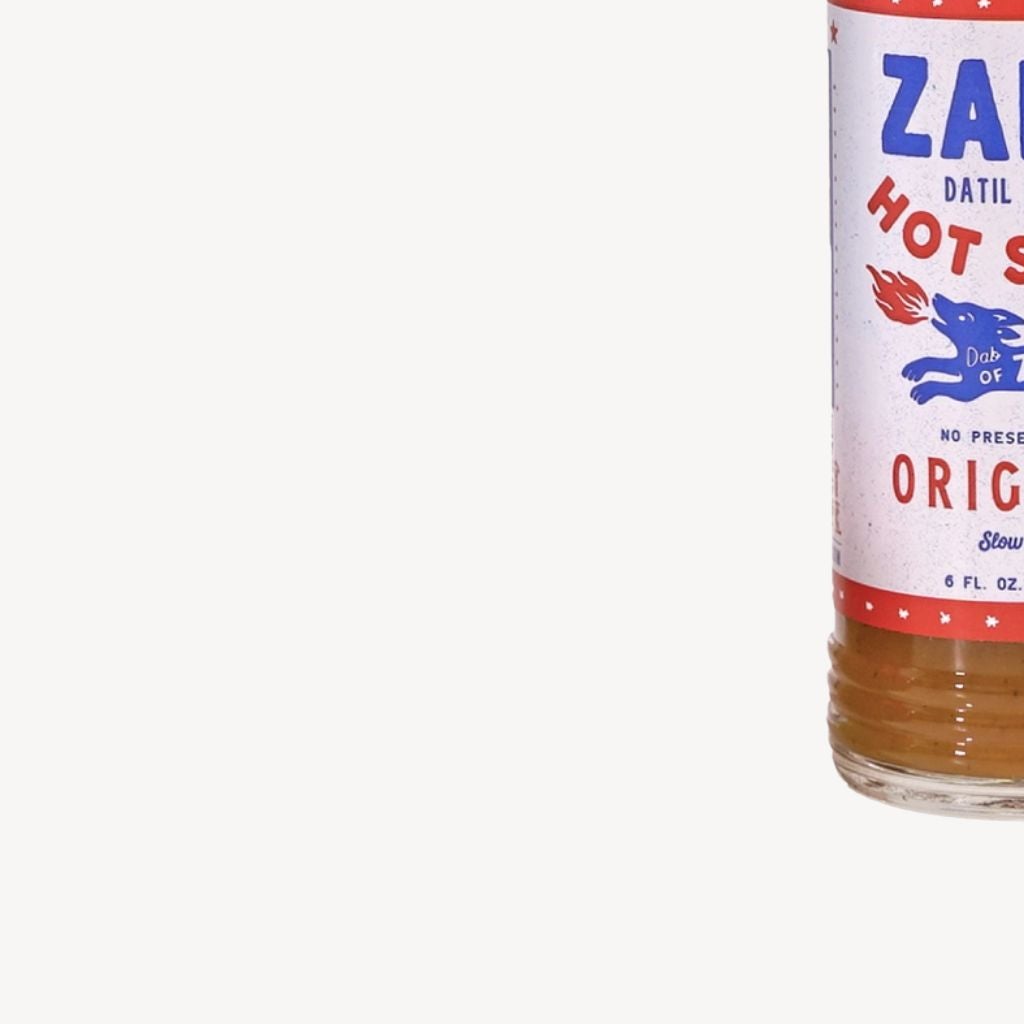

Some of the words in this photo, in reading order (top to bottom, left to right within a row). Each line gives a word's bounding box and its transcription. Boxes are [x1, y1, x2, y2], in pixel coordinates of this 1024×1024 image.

[945, 176, 1011, 204] DATIL
[867, 176, 982, 275] HOT
[966, 346, 1001, 367] Dab
[980, 367, 1003, 385] OF
[940, 428, 961, 442] NO
[978, 530, 1024, 552] Slow
[945, 574, 954, 588] 6
[963, 576, 987, 591] FL.
[997, 577, 1022, 591] OZ.
